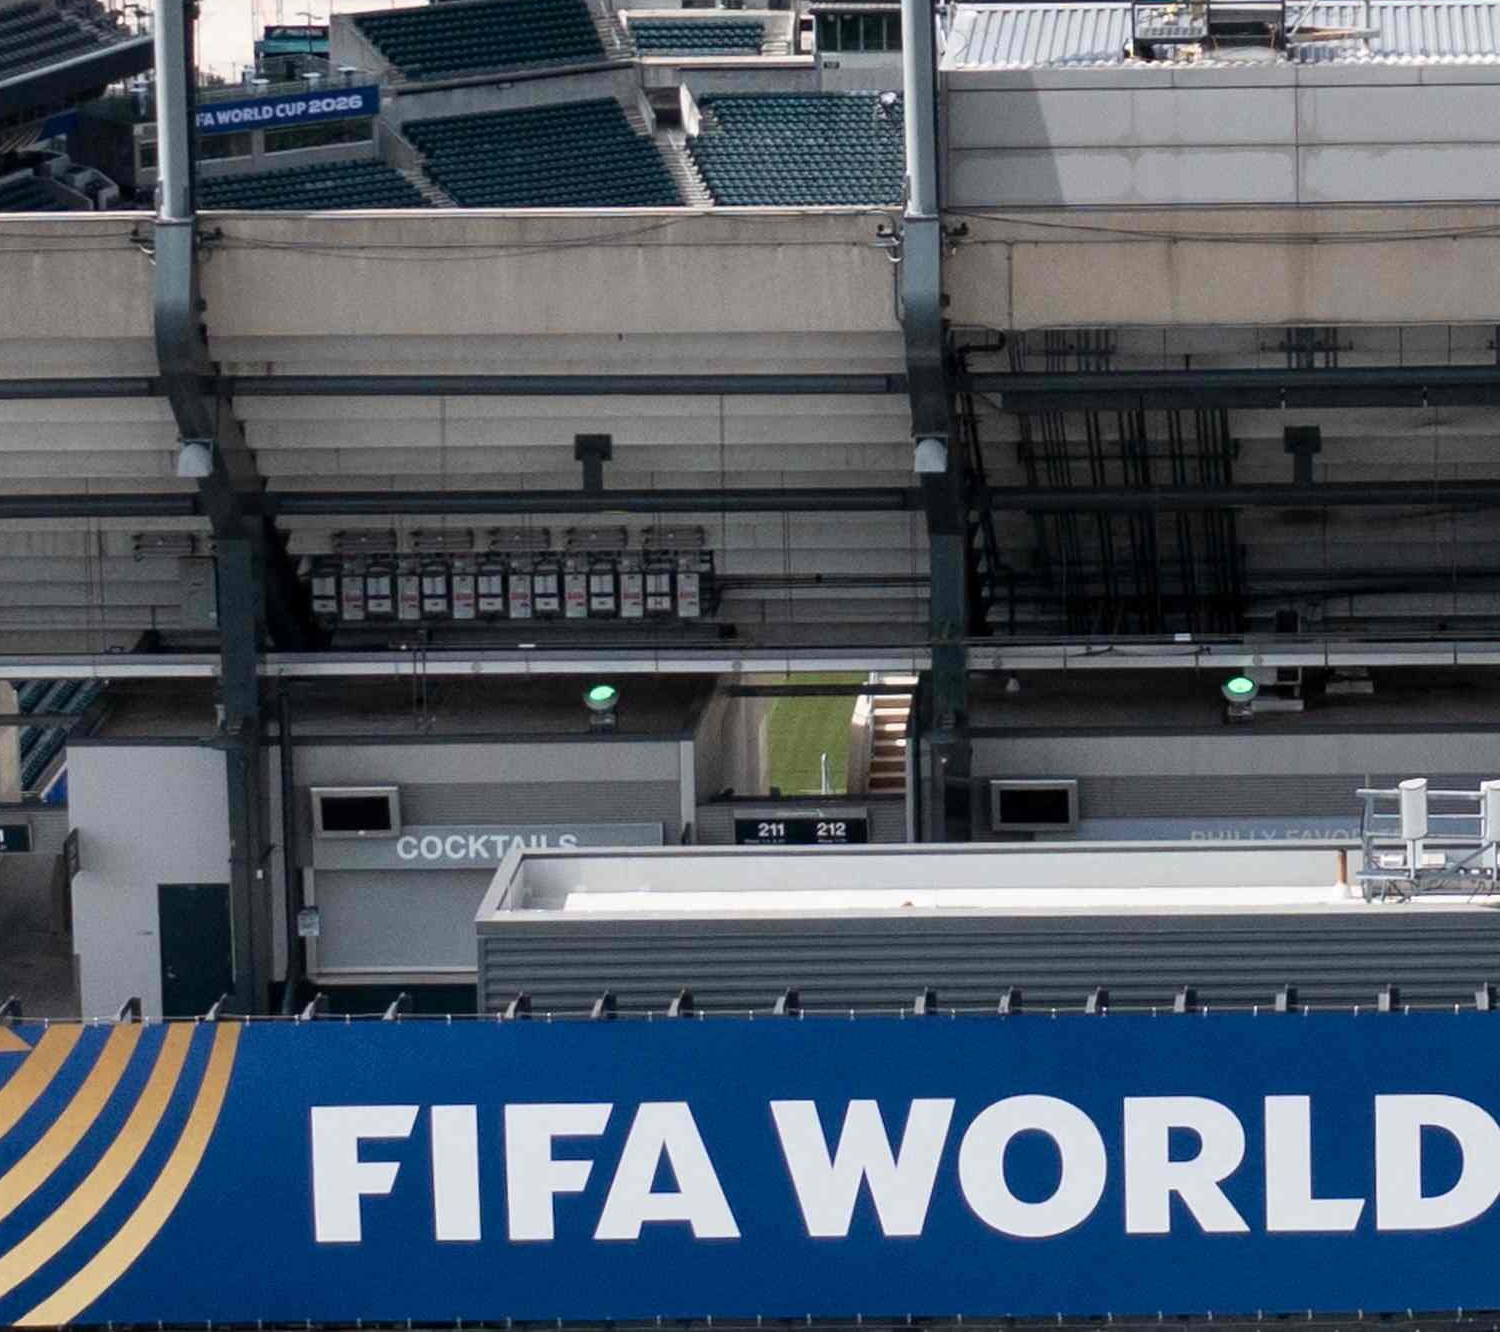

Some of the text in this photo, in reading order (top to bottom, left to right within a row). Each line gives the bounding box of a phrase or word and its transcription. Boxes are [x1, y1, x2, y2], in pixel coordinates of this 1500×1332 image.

[216, 105, 273, 125] WORLD
[275, 101, 307, 118] CUP
[307, 95, 363, 114] 2026
[757, 822, 846, 837] 211 212
[310, 1100, 741, 1243] FIFA
